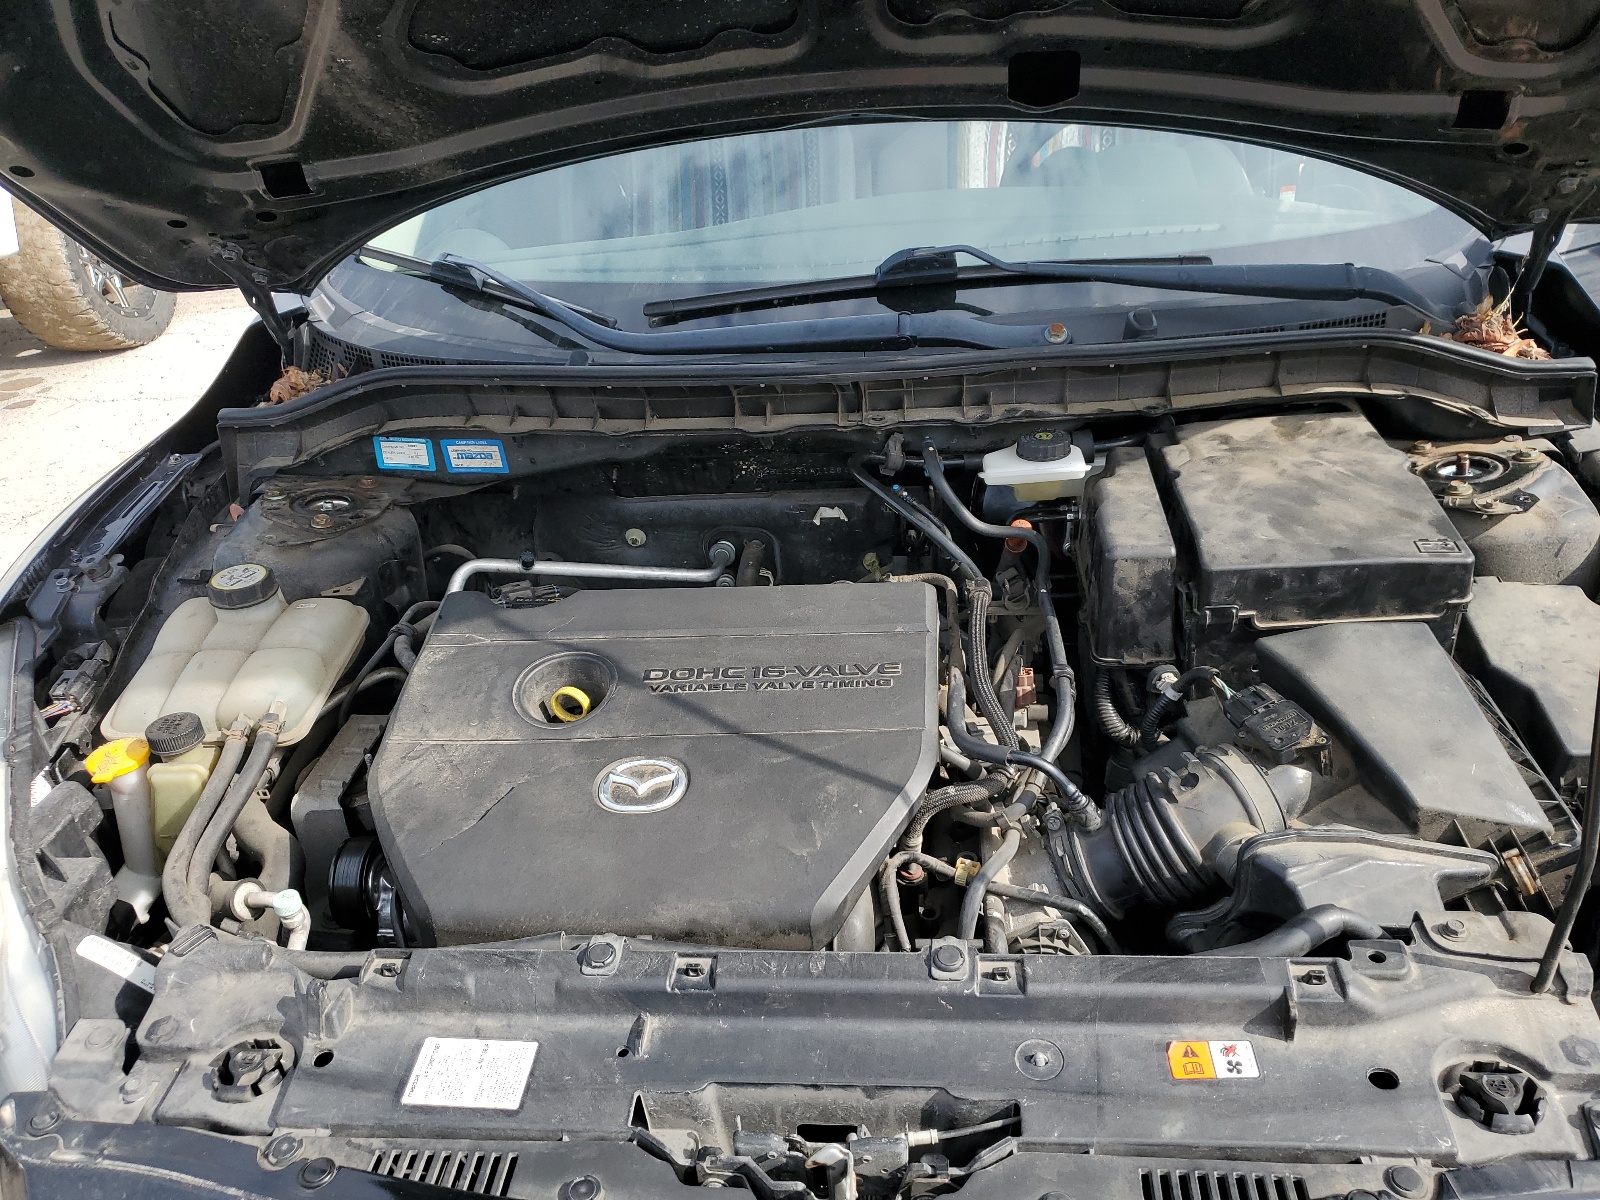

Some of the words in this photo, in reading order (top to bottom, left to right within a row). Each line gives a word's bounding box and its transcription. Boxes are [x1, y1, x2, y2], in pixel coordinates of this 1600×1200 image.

[643, 666, 748, 682] DOHC
[751, 662, 901, 680] 16-VALVE
[649, 682, 748, 694] VARIABLE
[752, 680, 816, 691] VALVE
[819, 678, 893, 689] TIMING
